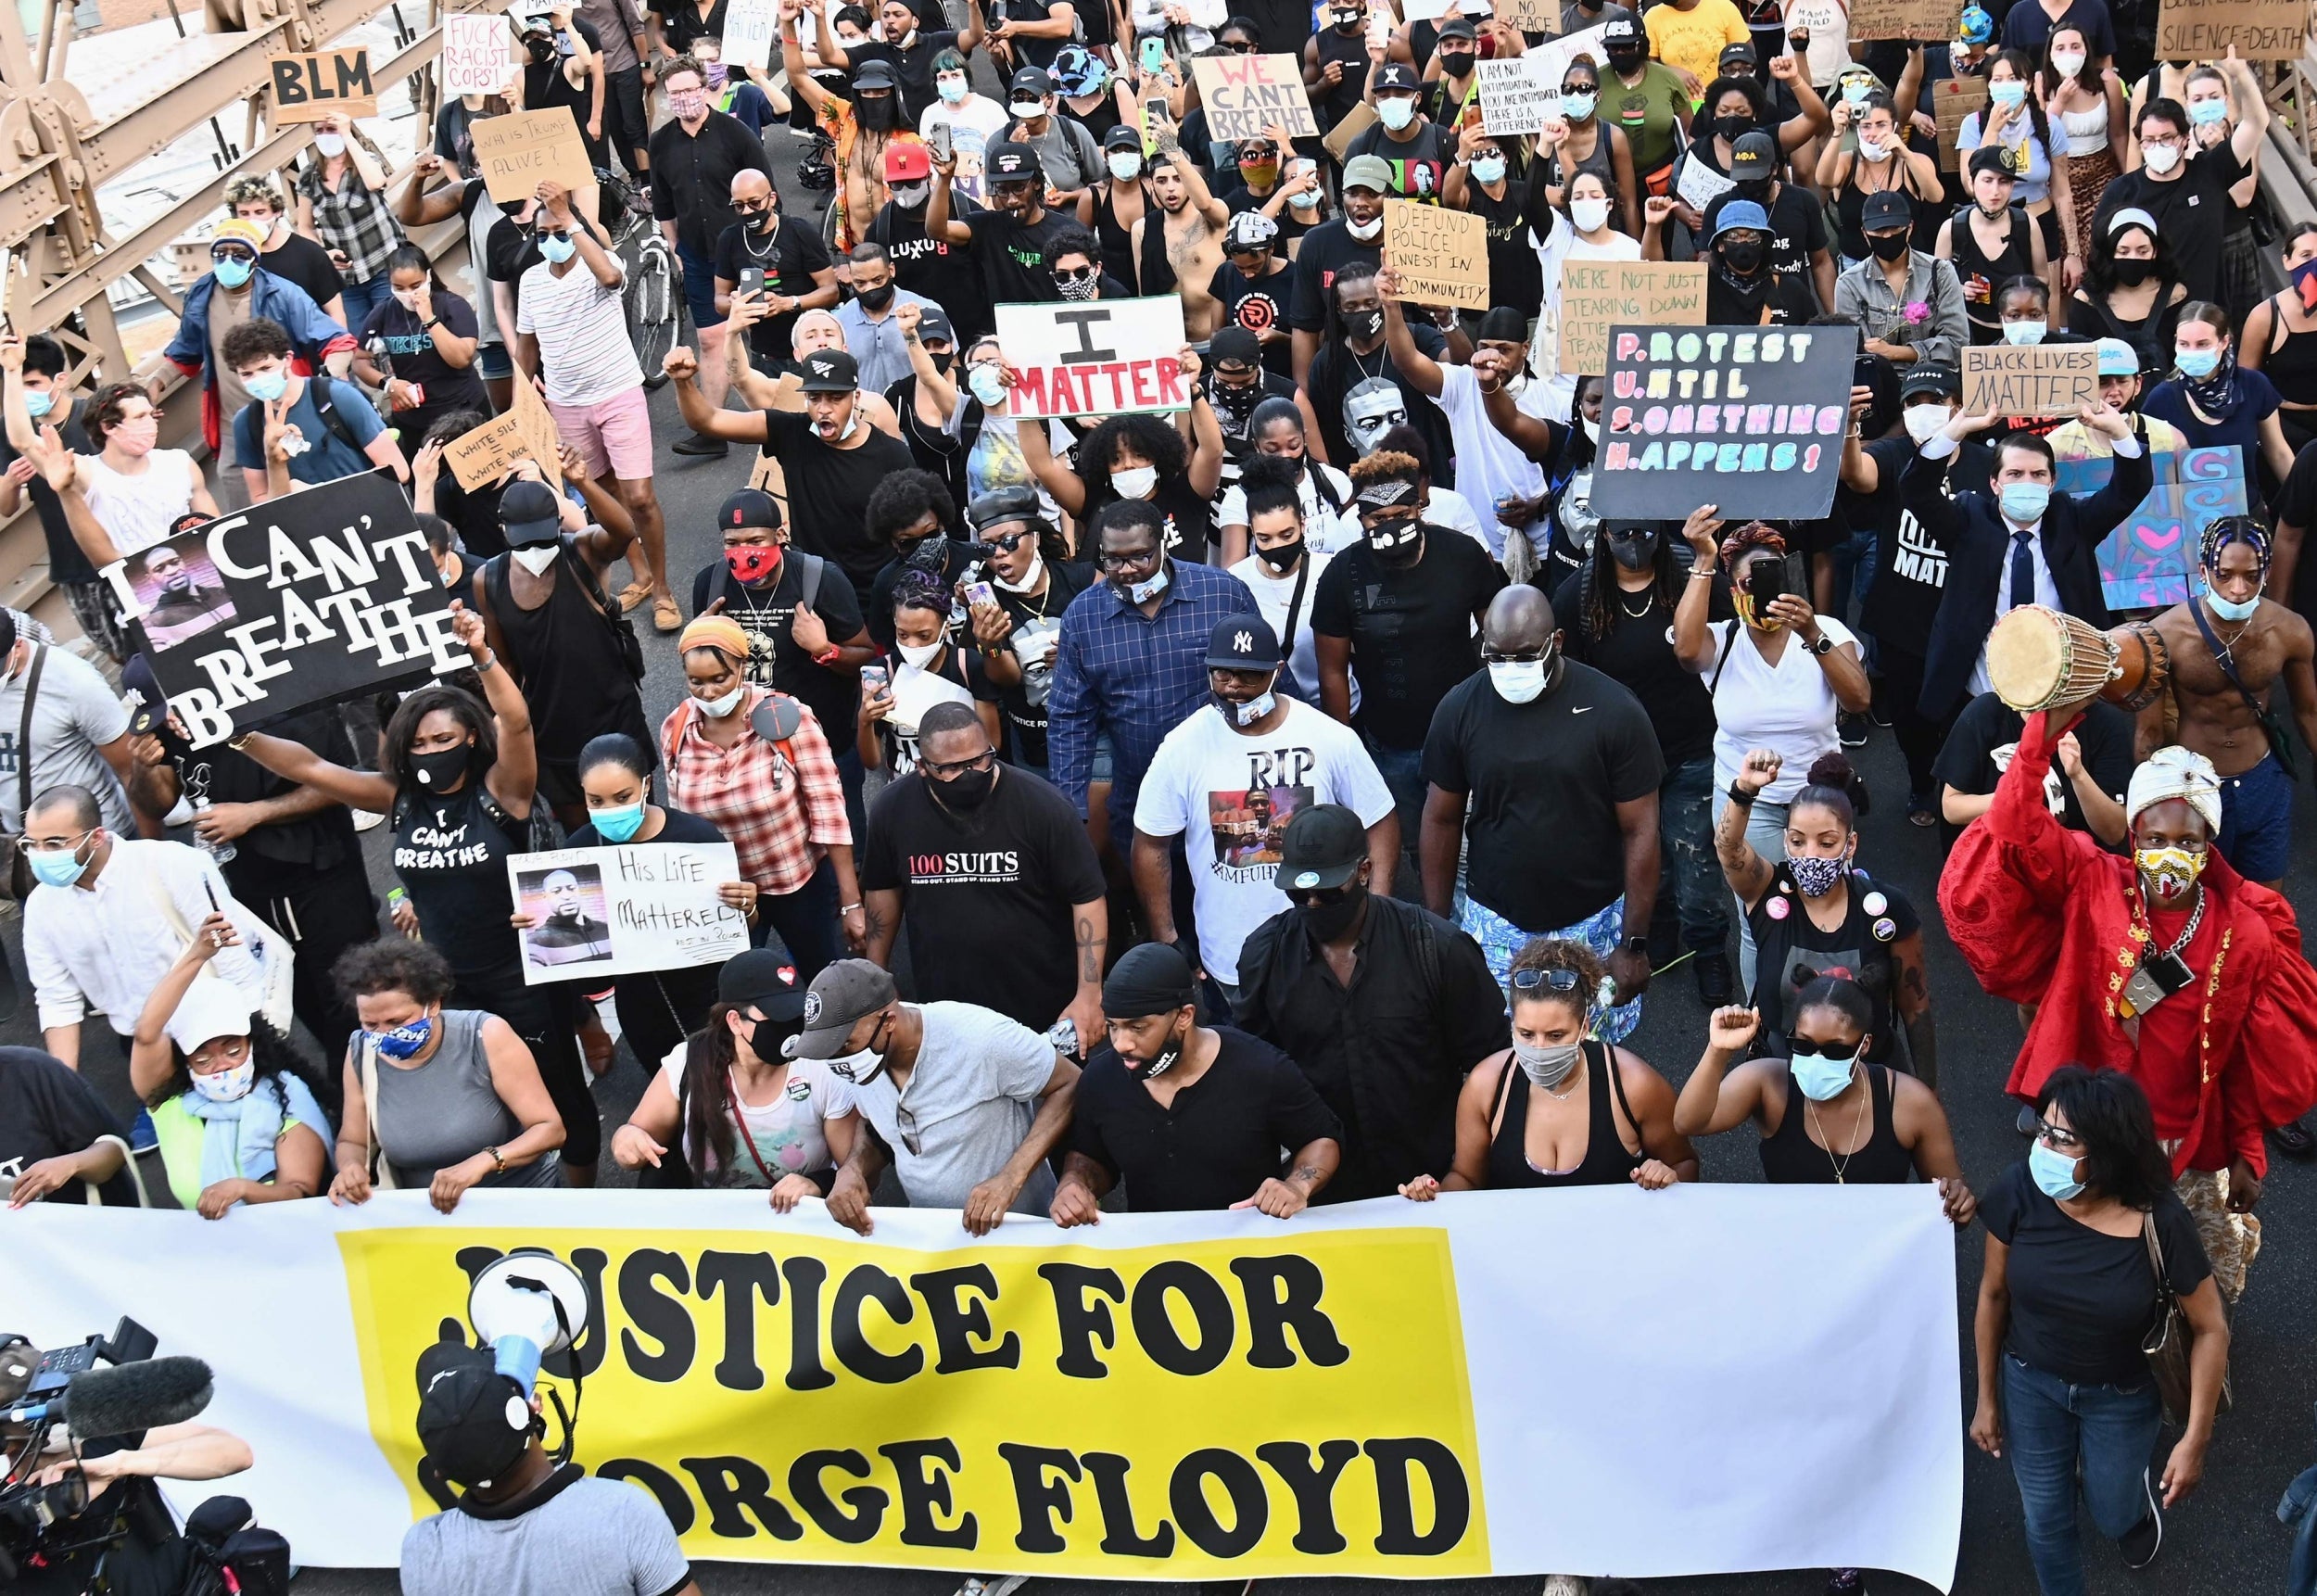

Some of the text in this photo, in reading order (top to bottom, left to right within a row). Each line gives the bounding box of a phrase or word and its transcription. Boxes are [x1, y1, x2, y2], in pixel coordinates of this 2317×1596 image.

[1518, 1, 1537, 15] NO
[450, 16, 505, 47] FUCK
[1509, 15, 1552, 33] PEACE
[445, 46, 510, 68] RACIST
[272, 50, 374, 106] BLM
[449, 67, 500, 88] COPS!
[1215, 56, 1274, 85] WE
[1478, 62, 1523, 81] I AM NOT
[1211, 83, 1297, 109] CANT
[1481, 79, 1537, 95] INTIMIDATING
[1483, 88, 1559, 108] YOU ARE INTIMIDATED
[1210, 107, 1314, 140] BREATHE
[1485, 107, 1535, 121] THERE IS A
[492, 149, 543, 176] ALIVE
[1398, 205, 1470, 234] DEFUND
[1391, 228, 1450, 253] POLICE
[1390, 250, 1473, 272] INVEST IN
[1398, 275, 1487, 305] COMMUNITY
[1621, 271, 1658, 292] NOT
[1663, 273, 1705, 290] JUST
[1565, 294, 1699, 321] TEARING DOWN
[1055, 309, 1117, 365] I
[1565, 322, 1614, 336] CITIE
[1969, 352, 2031, 372] BLACK
[2033, 351, 2094, 370] LIVES
[1004, 357, 1185, 415] MATTER
[1969, 374, 2094, 412] MATTER
[456, 433, 496, 459] WHITE
[466, 457, 505, 482] WHITE
[98, 557, 150, 622] I
[206, 513, 434, 597] CAN'T
[167, 586, 475, 752] BREATHE
[1247, 746, 1316, 789] RIP
[436, 808, 448, 828] I
[411, 824, 468, 848] CAN'T
[394, 842, 489, 869] BREATHE
[439, 1246, 1350, 1391] USTICE FOR
[997, 1437, 1471, 1559] FLOYD
